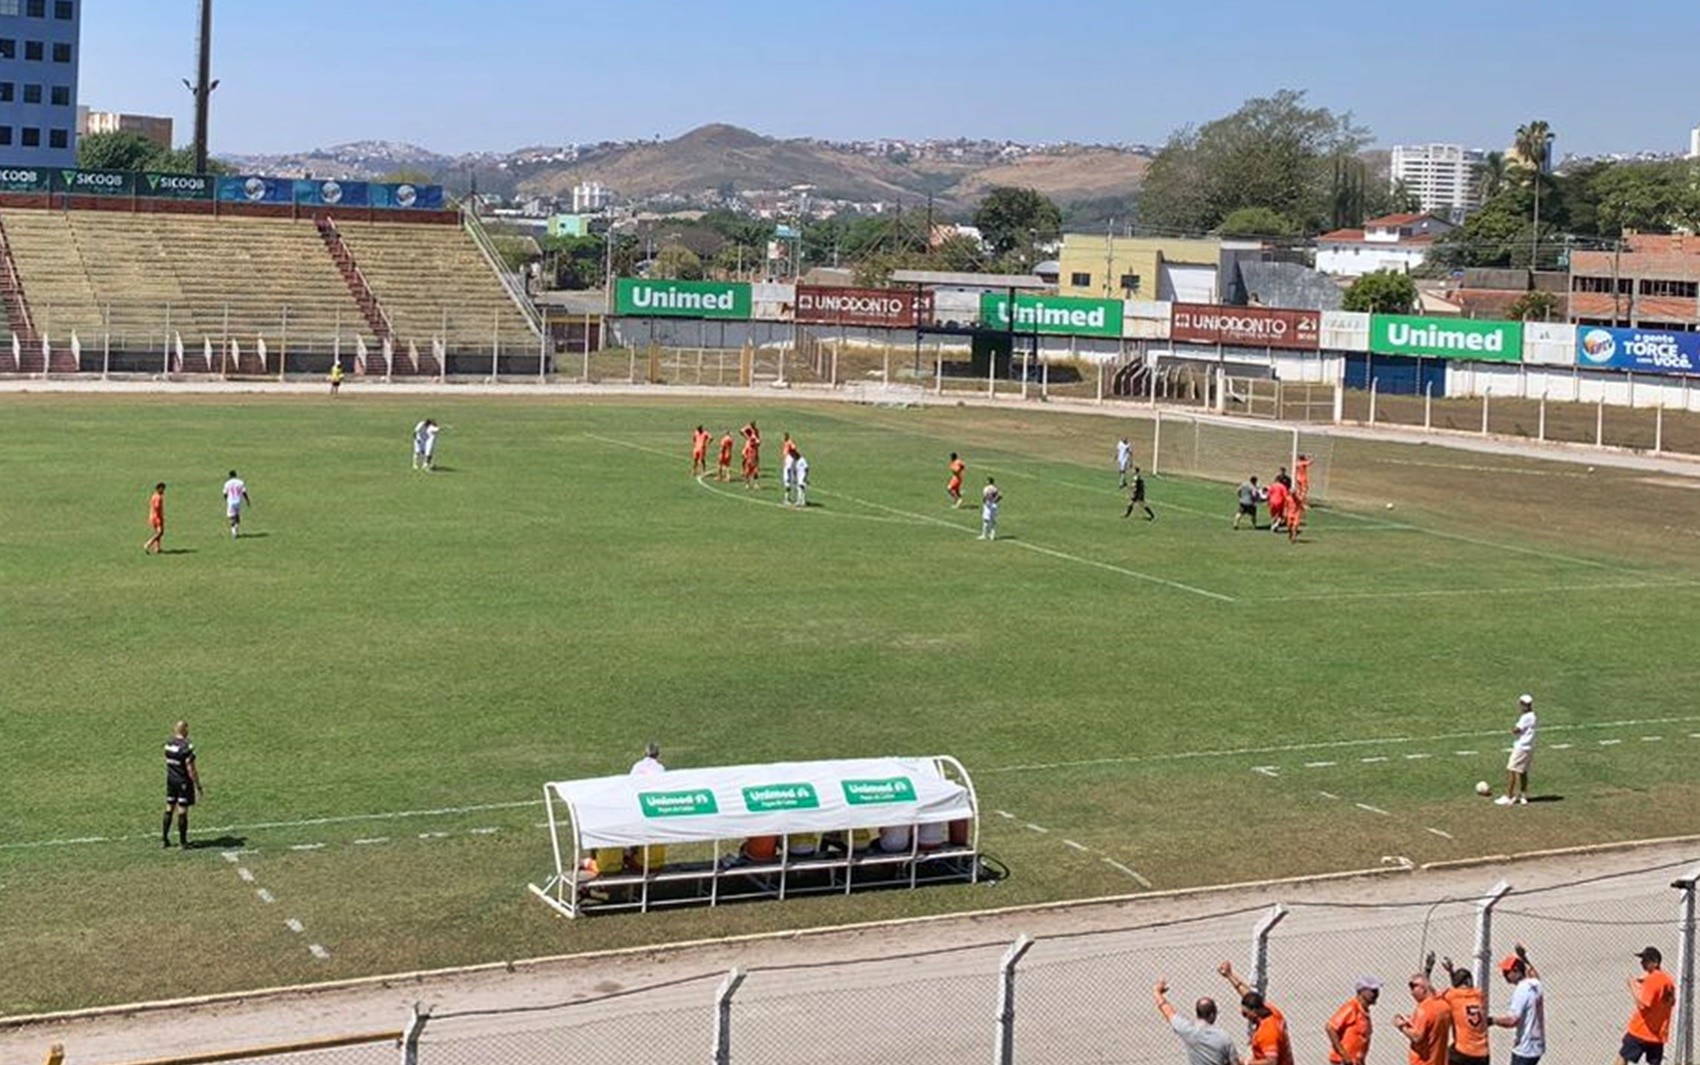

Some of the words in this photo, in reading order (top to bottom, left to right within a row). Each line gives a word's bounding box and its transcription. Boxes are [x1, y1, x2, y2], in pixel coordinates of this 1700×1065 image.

[76, 173, 123, 186] SICOOB
[160, 177, 205, 190] SICOOB
[632, 286, 734, 310] Unimed
[815, 295, 903, 313] UNIODONTO
[998, 301, 1105, 328] Unimed
[1192, 314, 1287, 334] UNIODONTO
[1387, 322, 1504, 352] Unimed
[1623, 341, 1678, 358] TORCE
[749, 788, 796, 801] Unimed
[848, 783, 893, 794] Unimed
[645, 795, 693, 807] Unimed
[1465, 1004, 1483, 1028] 5
